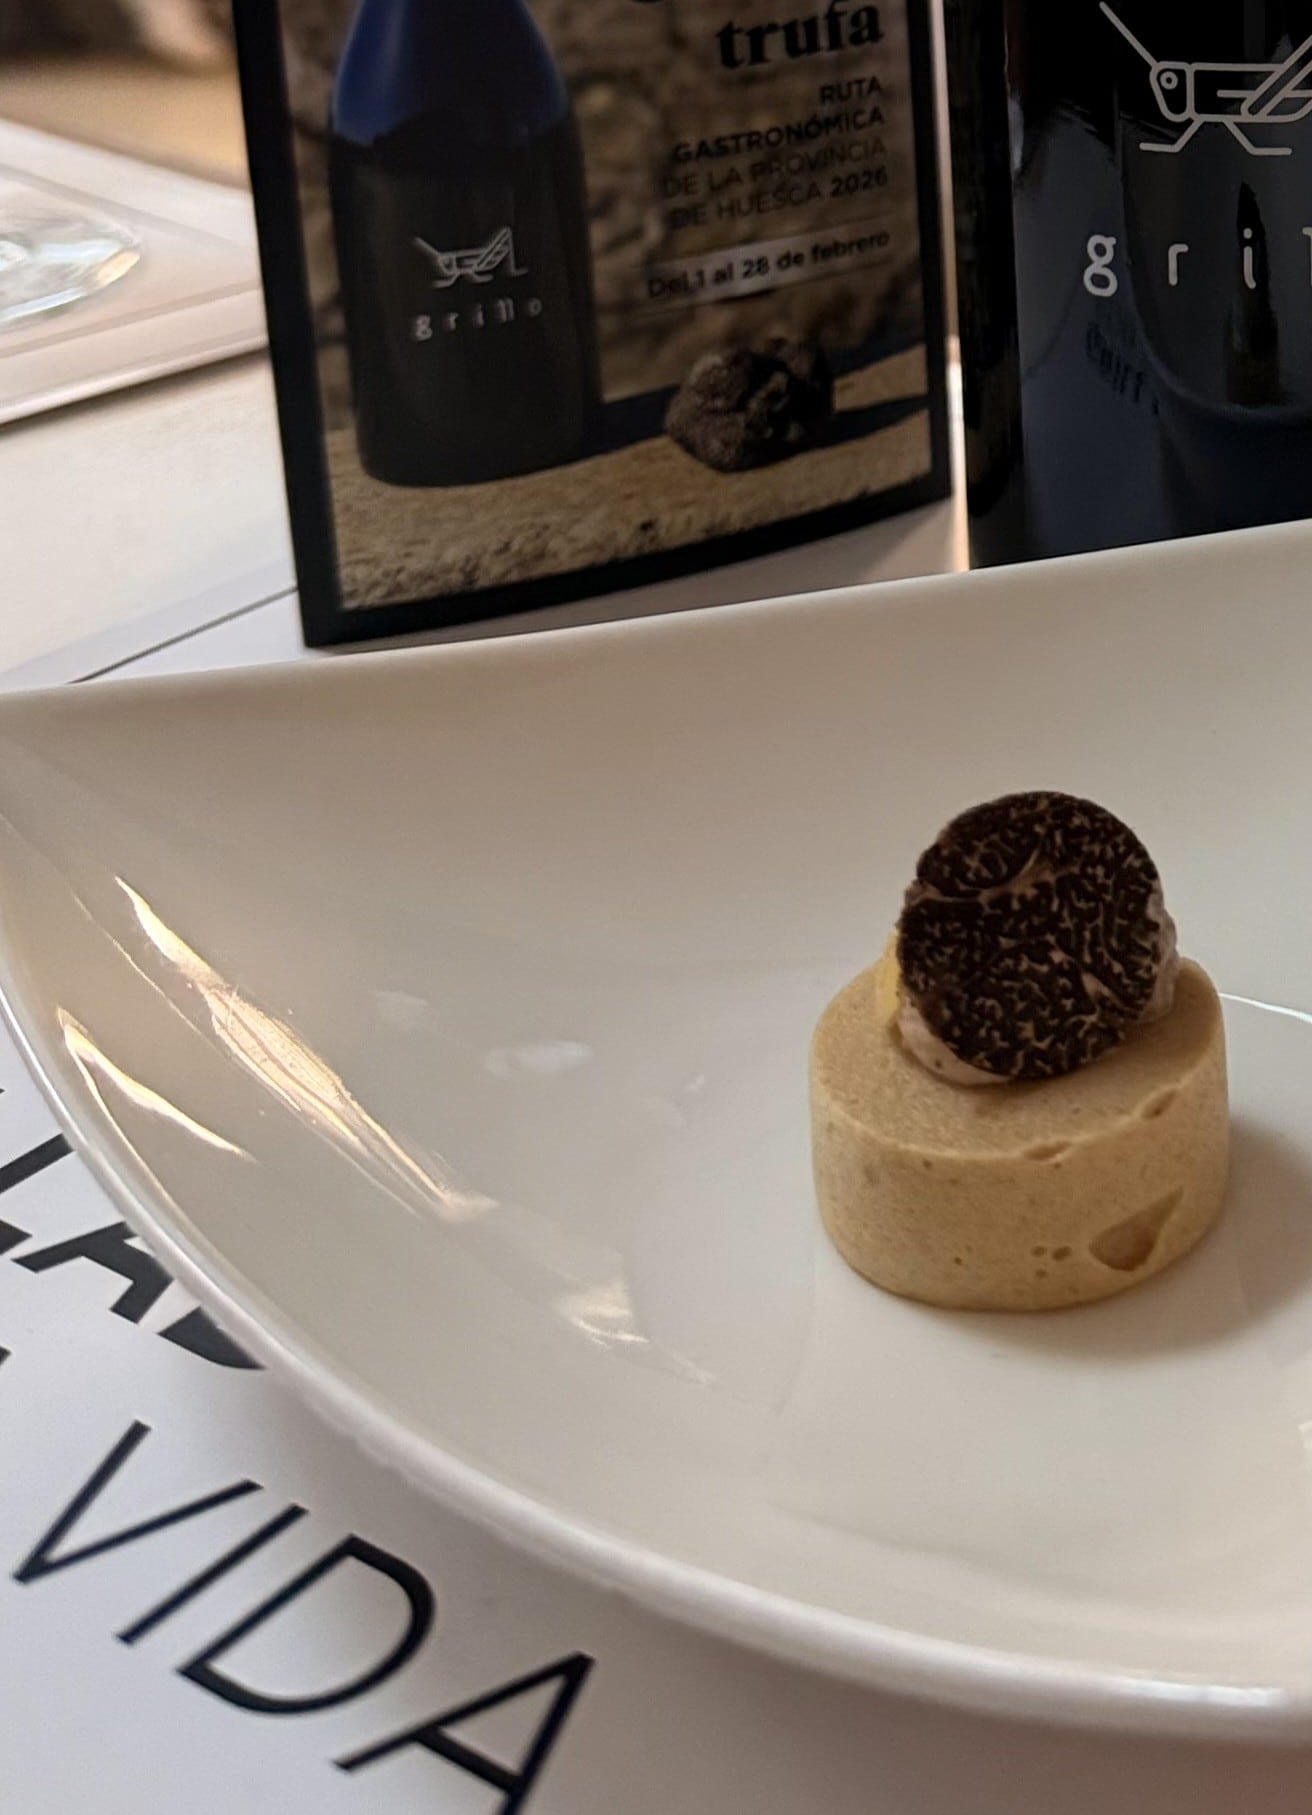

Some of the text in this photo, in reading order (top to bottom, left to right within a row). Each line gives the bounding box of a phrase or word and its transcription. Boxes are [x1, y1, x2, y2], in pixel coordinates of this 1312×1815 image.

[820, 75, 883, 105] RUTA
[671, 105, 886, 164] GASTRONÓMICA
[661, 135, 887, 199] DE LA PROVINCIA
[668, 165, 889, 230] DE HUESCA 2026
[647, 271, 689, 298] Del
[713, 262, 734, 285] al
[741, 256, 771, 280] 28
[776, 248, 806, 271] de
[811, 232, 892, 264] febrero
[415, 297, 543, 342] grillo
[14, 1418, 597, 1815] VIDA
